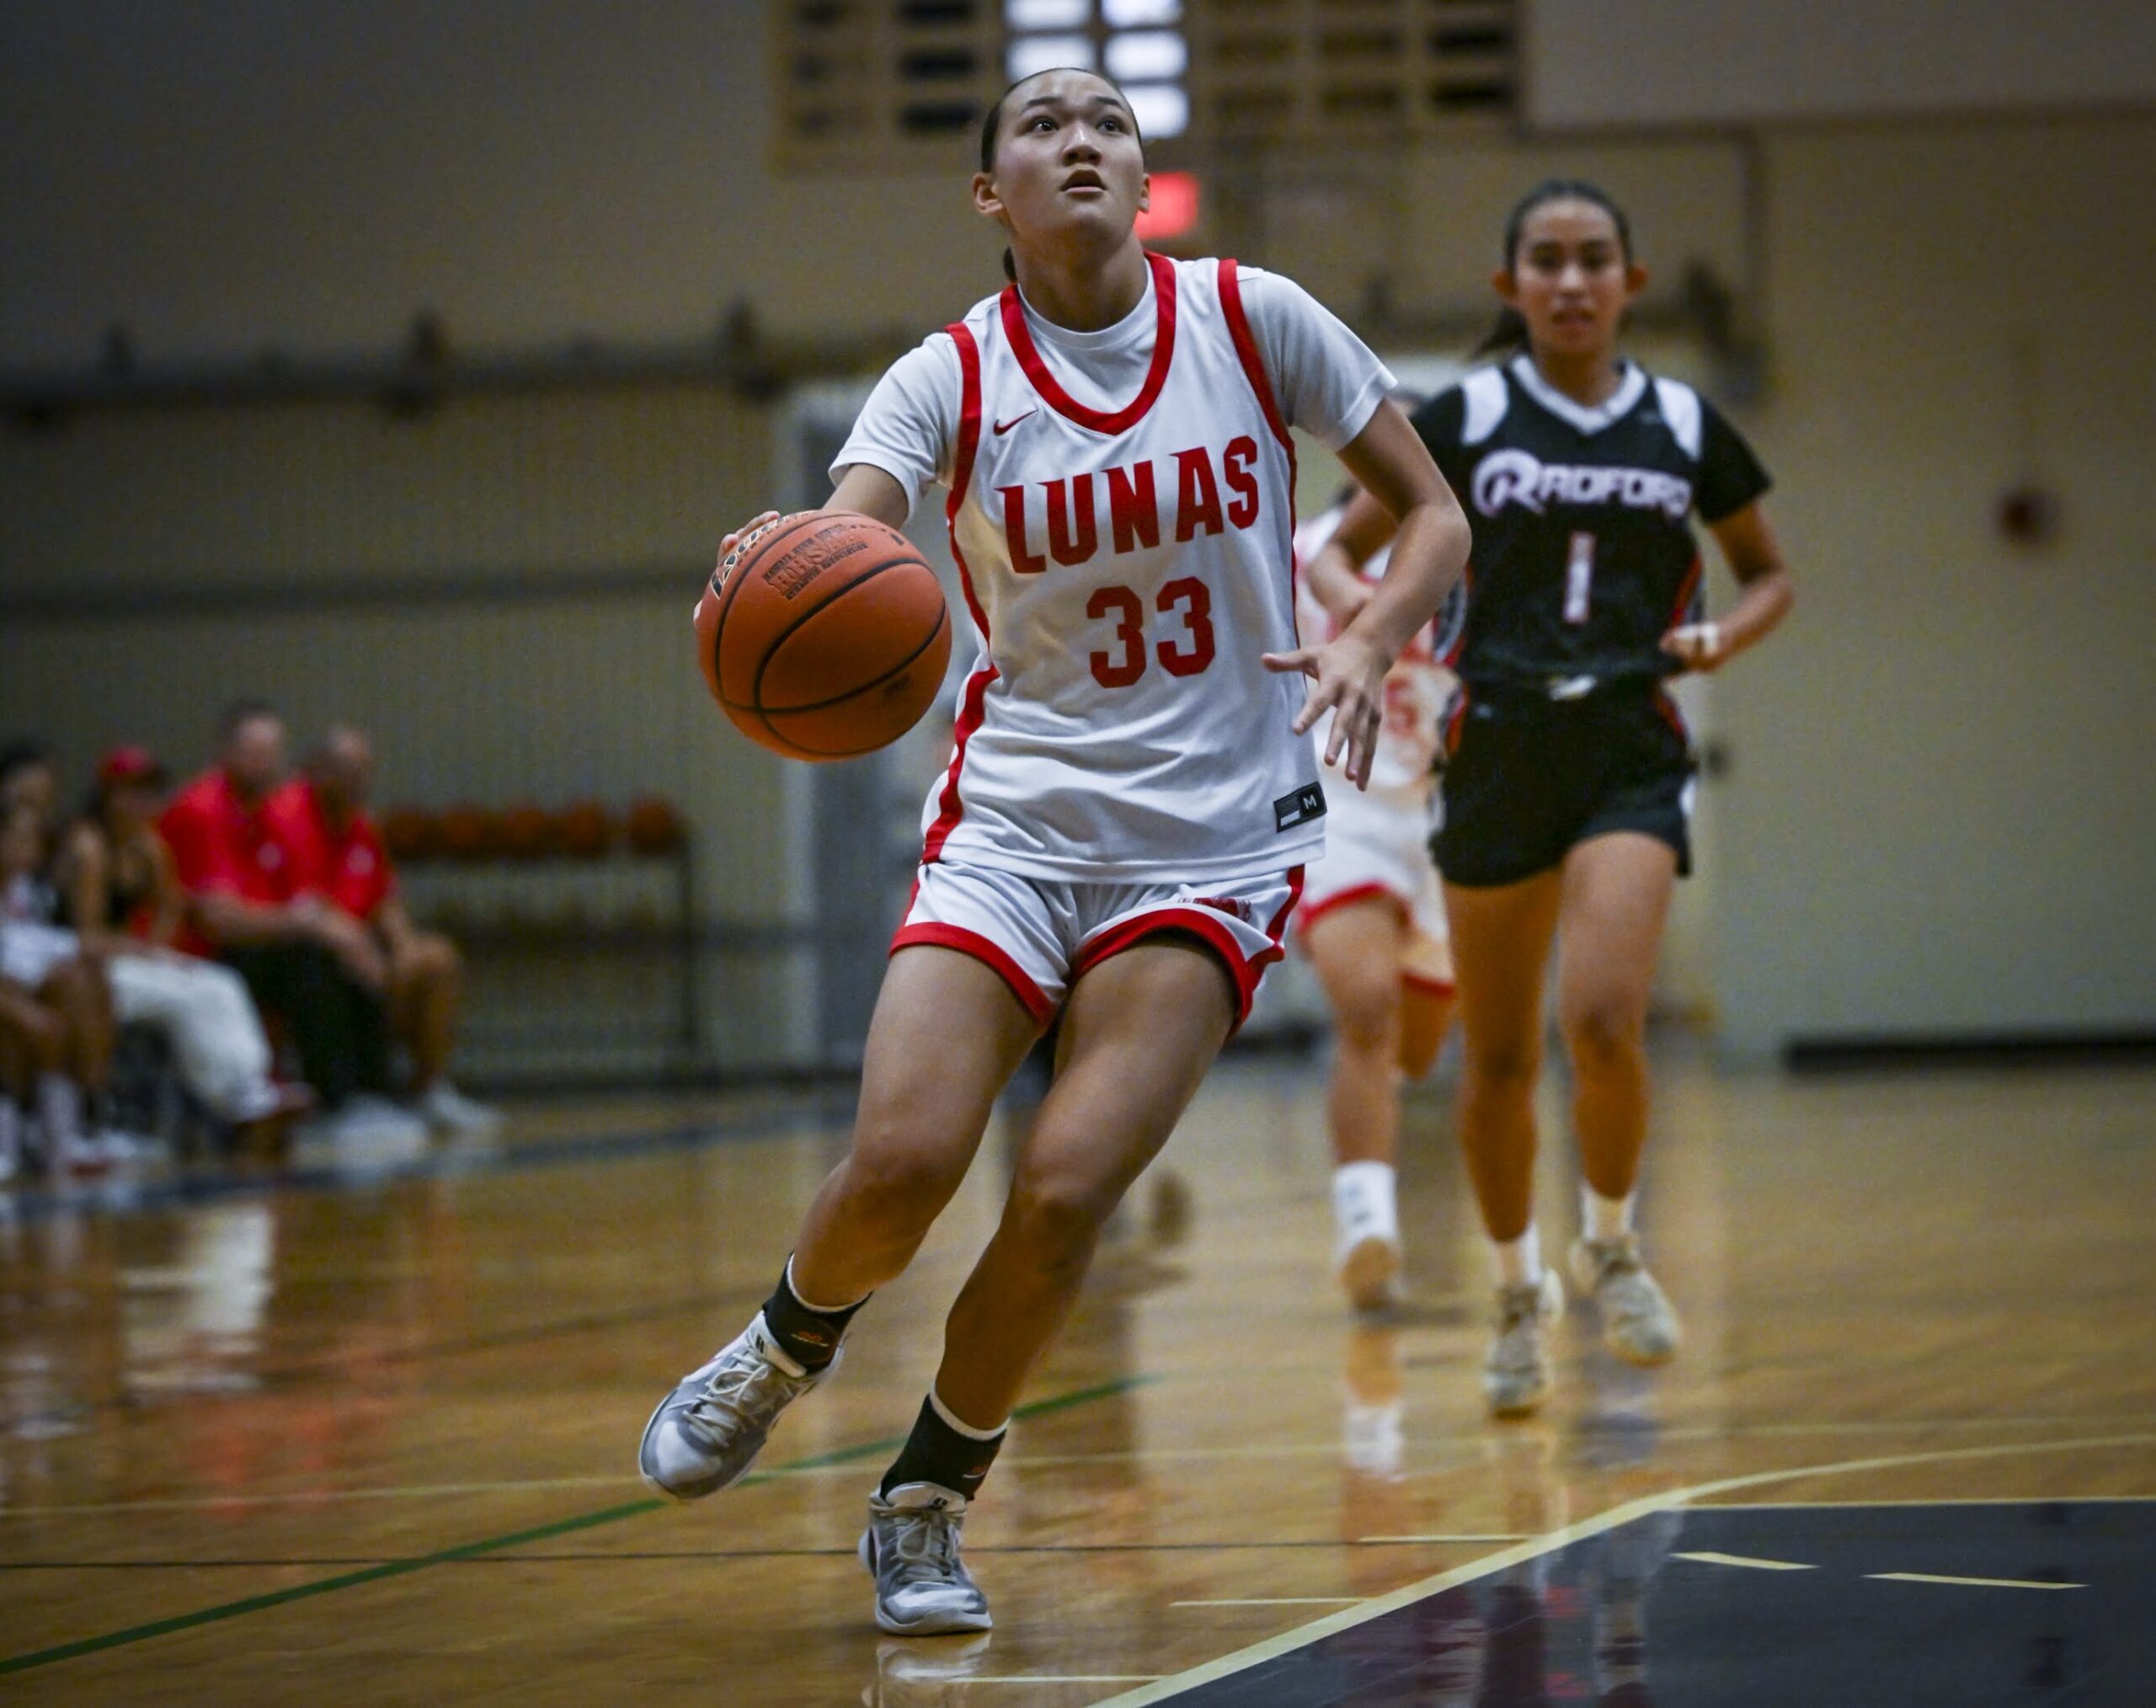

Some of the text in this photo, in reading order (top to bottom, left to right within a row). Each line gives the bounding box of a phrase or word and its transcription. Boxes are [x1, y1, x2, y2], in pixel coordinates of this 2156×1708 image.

[995, 435, 1259, 574] LUNAS
[1562, 530, 1596, 624] 1
[1086, 576, 1215, 689] 33
[1302, 794, 1318, 809] M
